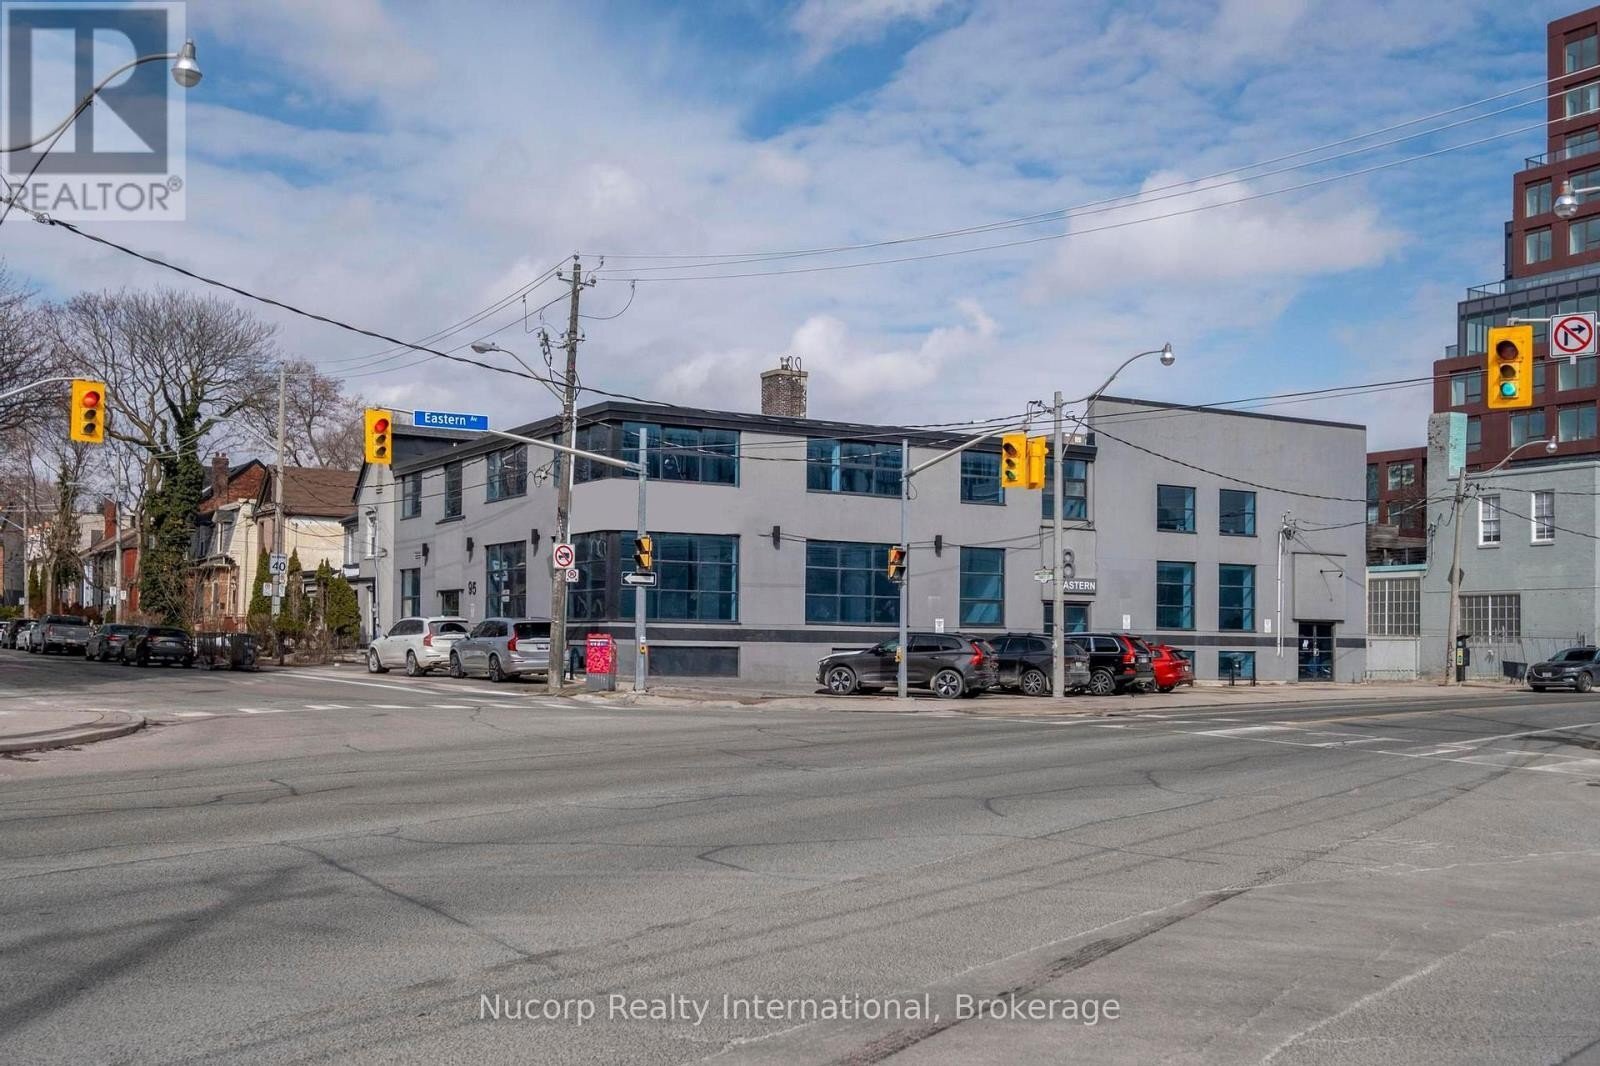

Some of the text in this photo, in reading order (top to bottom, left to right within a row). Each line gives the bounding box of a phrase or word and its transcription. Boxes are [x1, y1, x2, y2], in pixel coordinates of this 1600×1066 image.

[424, 412, 466, 426] Eastern
[272, 561, 286, 571] 40
[468, 581, 477, 595] 95
[1063, 581, 1096, 590] ASTERN
